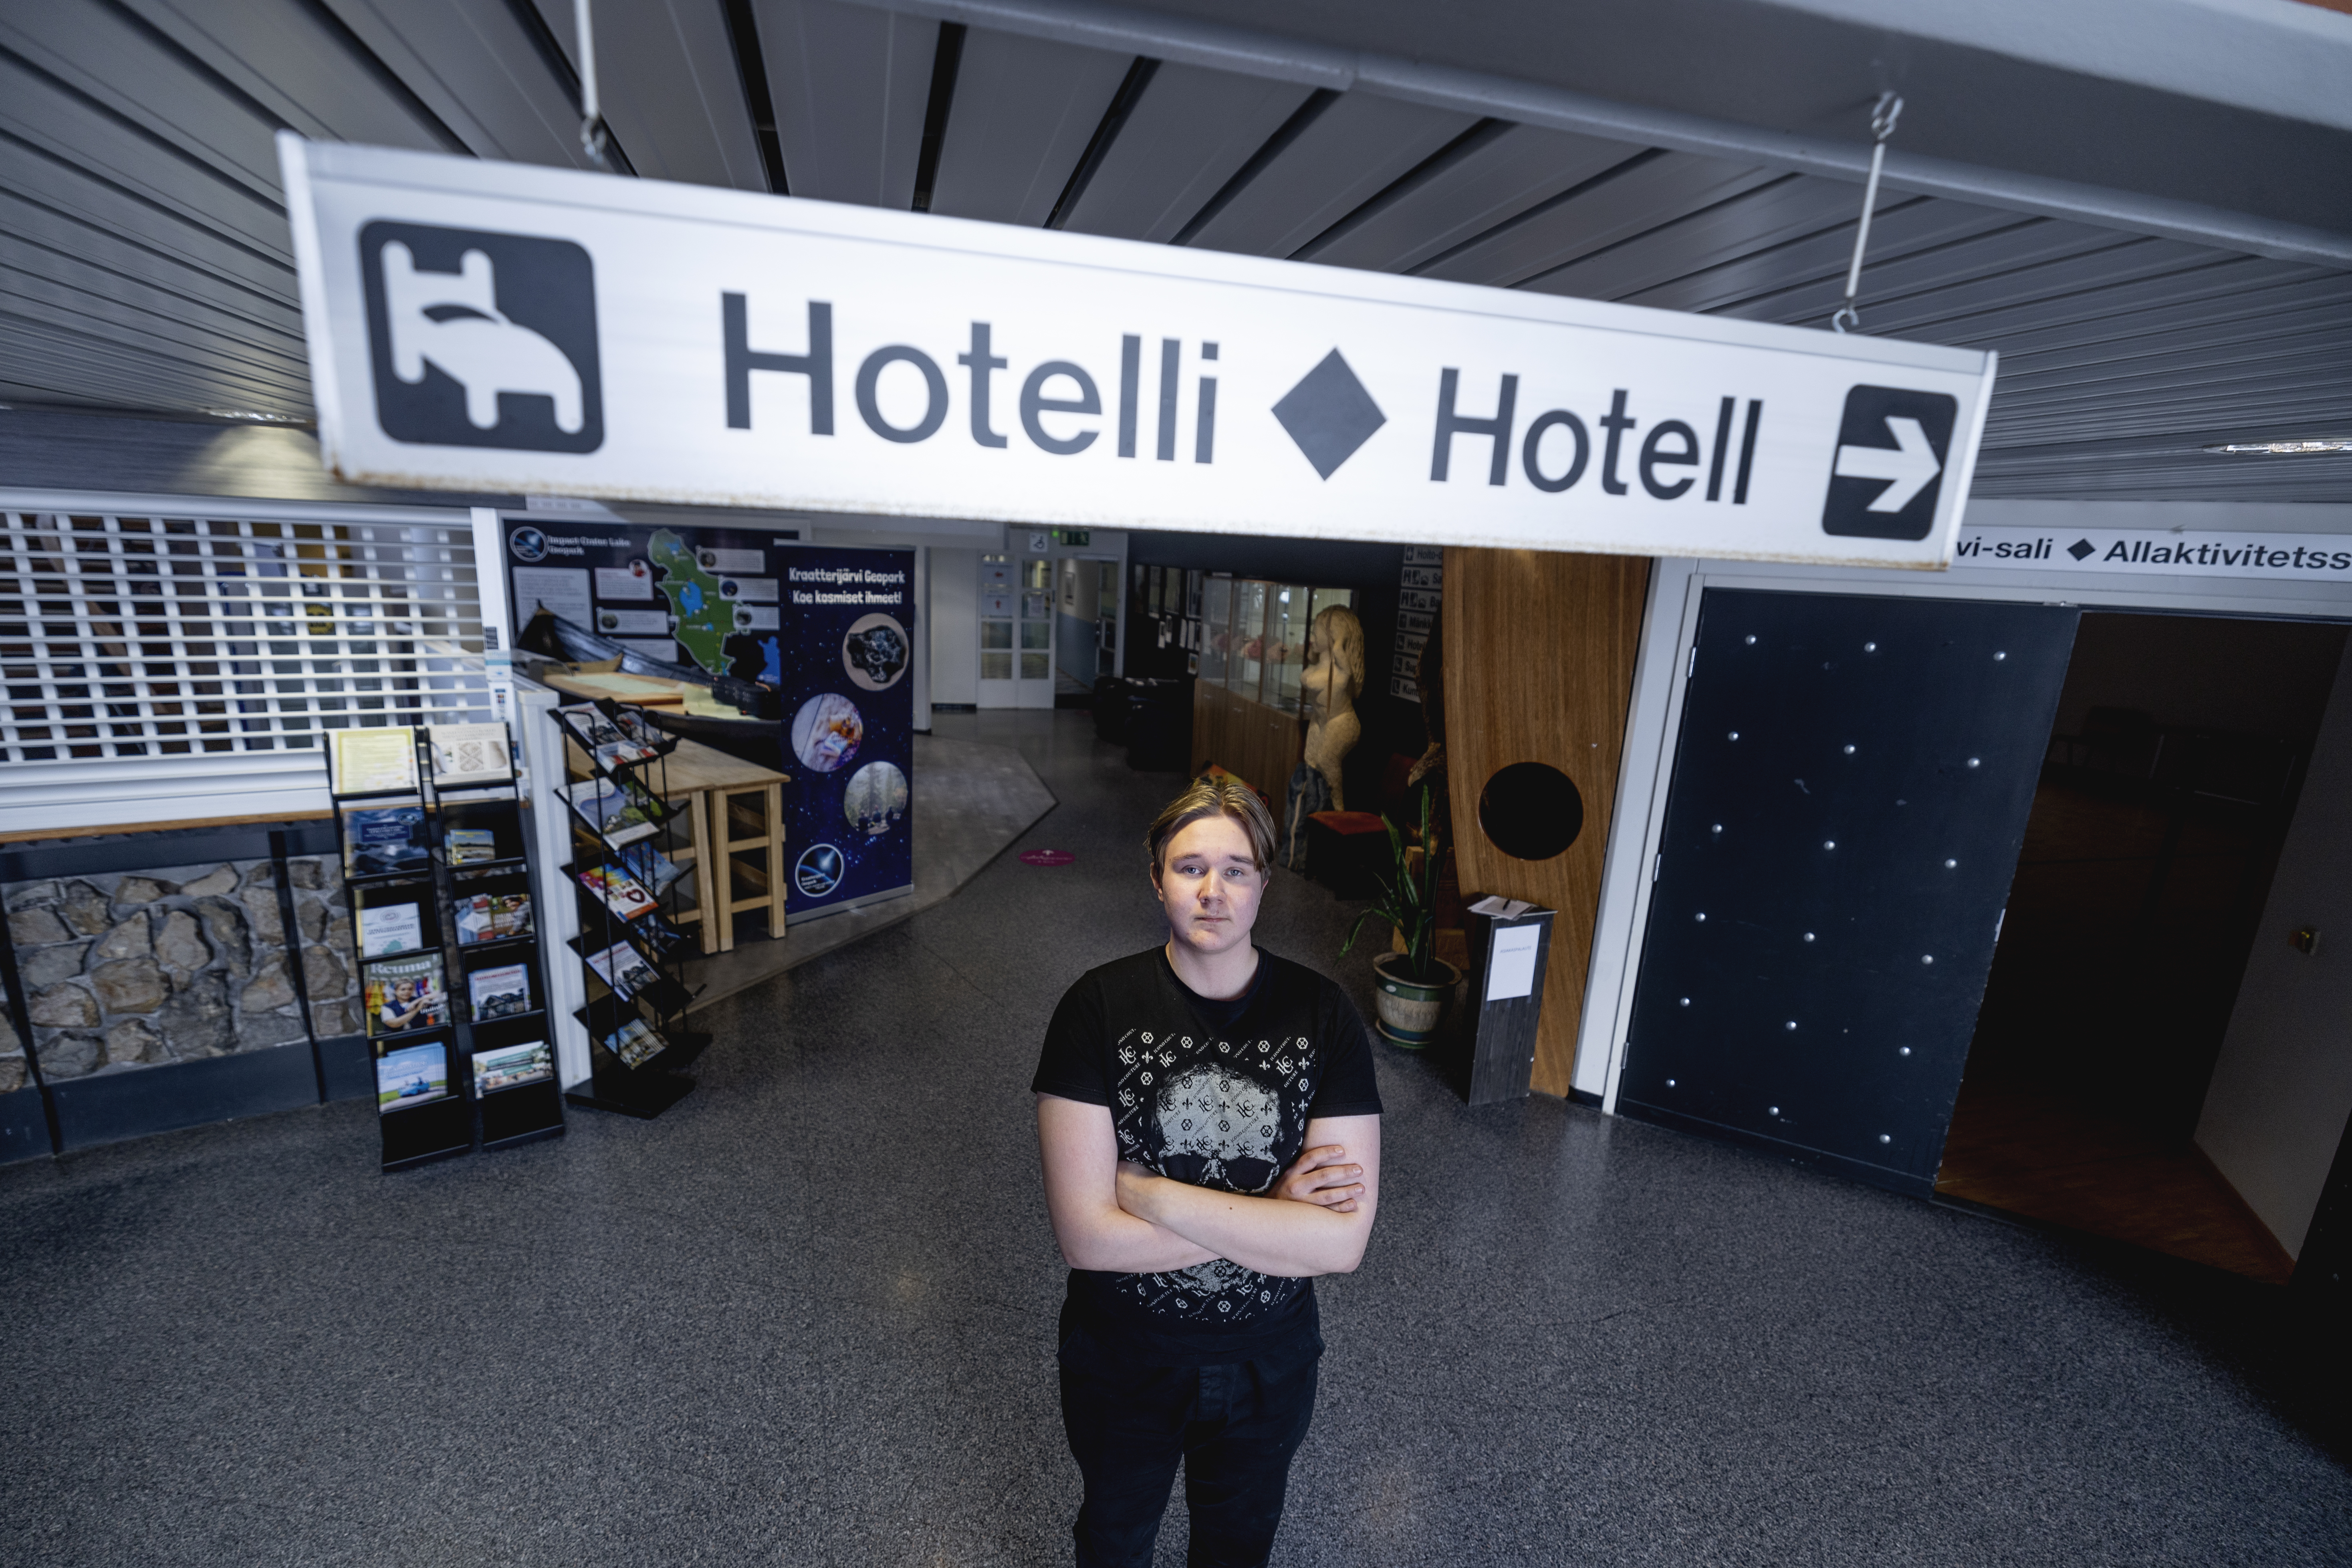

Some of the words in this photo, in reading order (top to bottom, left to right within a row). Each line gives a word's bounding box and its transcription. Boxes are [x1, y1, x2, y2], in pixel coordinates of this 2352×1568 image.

[721, 292, 1219, 464] Hotelli
[1430, 367, 1763, 505] Hotell
[2103, 540, 2352, 570] Allaktivitetss
[789, 567, 863, 585] Kraatterijärvi
[864, 569, 905, 586] Geopark
[793, 590, 814, 604] Koe
[815, 589, 864, 605] kosmiset
[865, 590, 902, 605] ihmeet!
[370, 961, 432, 974] Reuma
[1124, 1028, 1136, 1038] COUT
[1153, 1042, 1165, 1054] ICONO
[1164, 1033, 1176, 1044] COUT
[1270, 1047, 1281, 1061] ICONO
[1280, 1036, 1291, 1049] COUT
[1124, 1062, 1141, 1080] COUTURE
[1123, 1104, 1139, 1121] COUTURE
[1202, 1110, 1219, 1128] COUTURE
[1230, 1132, 1243, 1143] ICONO
[1242, 1115, 1260, 1133] COUTURE
